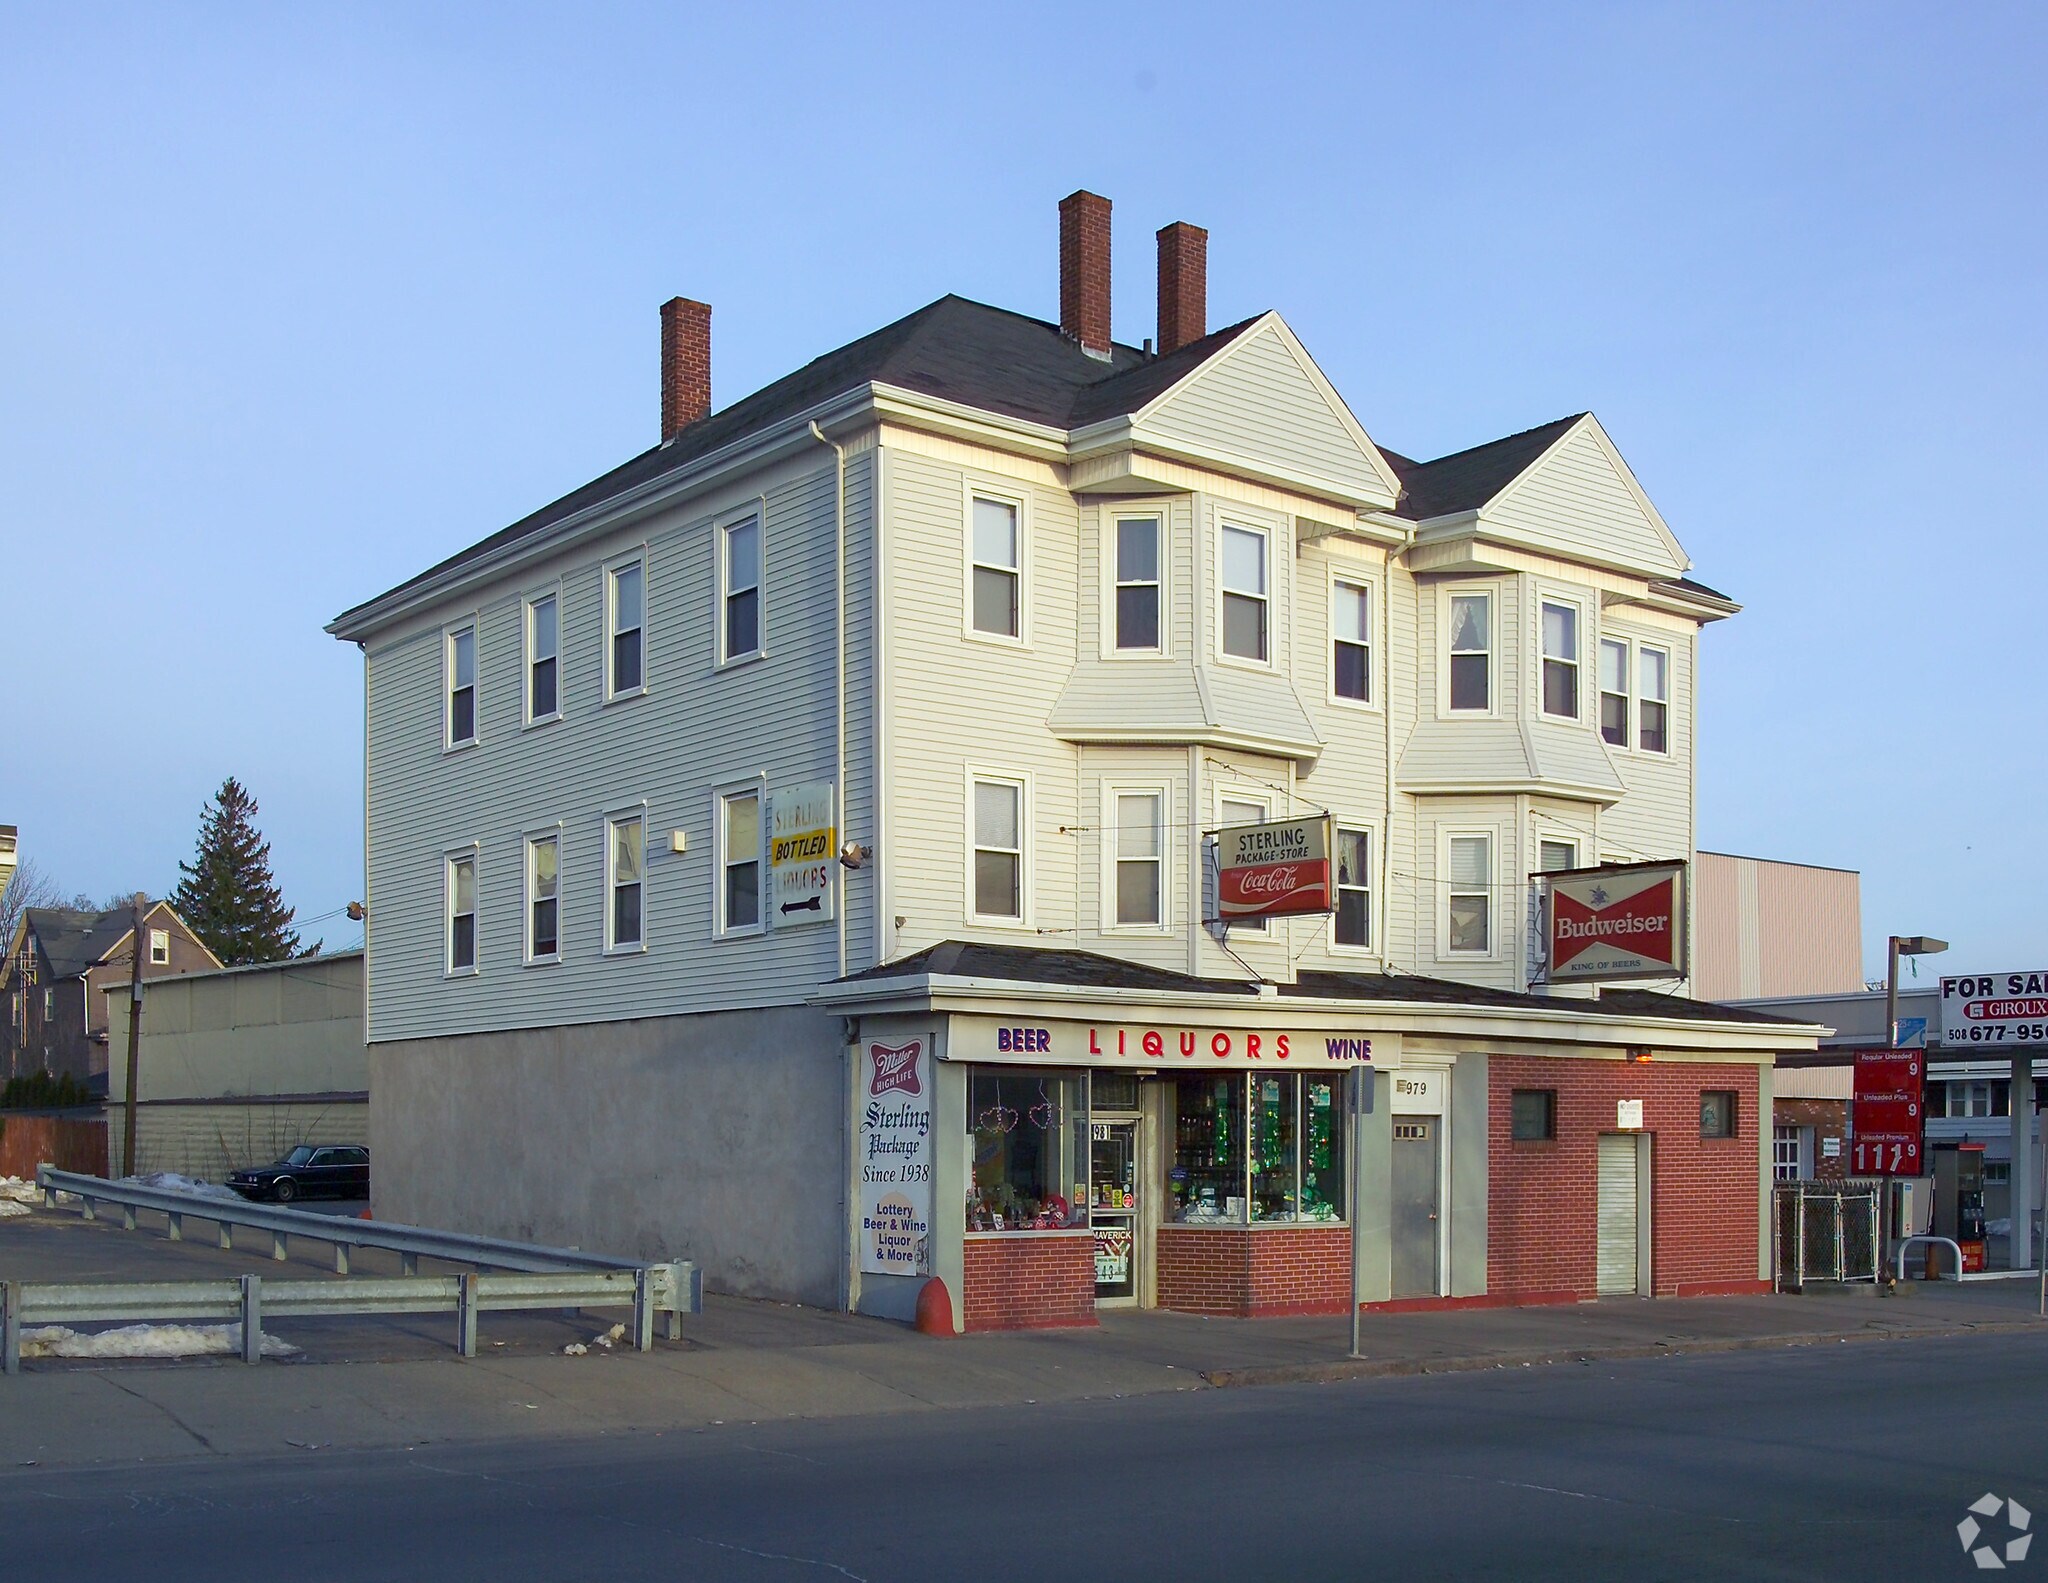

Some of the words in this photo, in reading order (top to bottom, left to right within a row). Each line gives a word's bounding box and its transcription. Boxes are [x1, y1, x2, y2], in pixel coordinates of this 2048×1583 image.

[775, 835, 827, 861] BOTTLED
[1239, 828, 1305, 851] STERLING
[1240, 866, 1299, 895] Coca-Cola
[1557, 912, 1668, 939] Budweiser
[1571, 962, 1594, 971] KING
[1597, 961, 1610, 969] OF
[1612, 959, 1641, 969] BEERS
[1943, 976, 1994, 998] FOR
[1989, 1000, 2047, 1016] GIROUX
[1948, 1028, 1968, 1040] 508
[1969, 1023, 2048, 1041] 677-95
[998, 1027, 1051, 1053] BEER
[1089, 1028, 1291, 1059] LIQUORS
[1325, 1038, 1372, 1061] WINE
[876, 1050, 913, 1075] Miller
[1861, 1053, 1883, 1061] Regular
[1885, 1052, 1912, 1060] Unleaded
[1909, 1062, 1918, 1076] 9
[876, 1077, 895, 1092] HIGH
[896, 1069, 912, 1084] LIFE
[1406, 1082, 1427, 1095] 979
[1908, 1103, 1917, 1116] 9
[859, 1101, 930, 1137] Sterling
[1094, 1125, 1110, 1139] 981
[868, 1133, 920, 1160] Package
[862, 1165, 896, 1182] Since
[900, 1164, 930, 1182] 1938
[877, 1203, 913, 1218] Lottery
[863, 1217, 887, 1230] Beer
[890, 1218, 898, 1231] &
[901, 1219, 926, 1231] Wine
[878, 1233, 911, 1248] Liquor
[1093, 1230, 1132, 1240] MAVERICK
[876, 1248, 884, 1260] &
[887, 1248, 913, 1261] More
